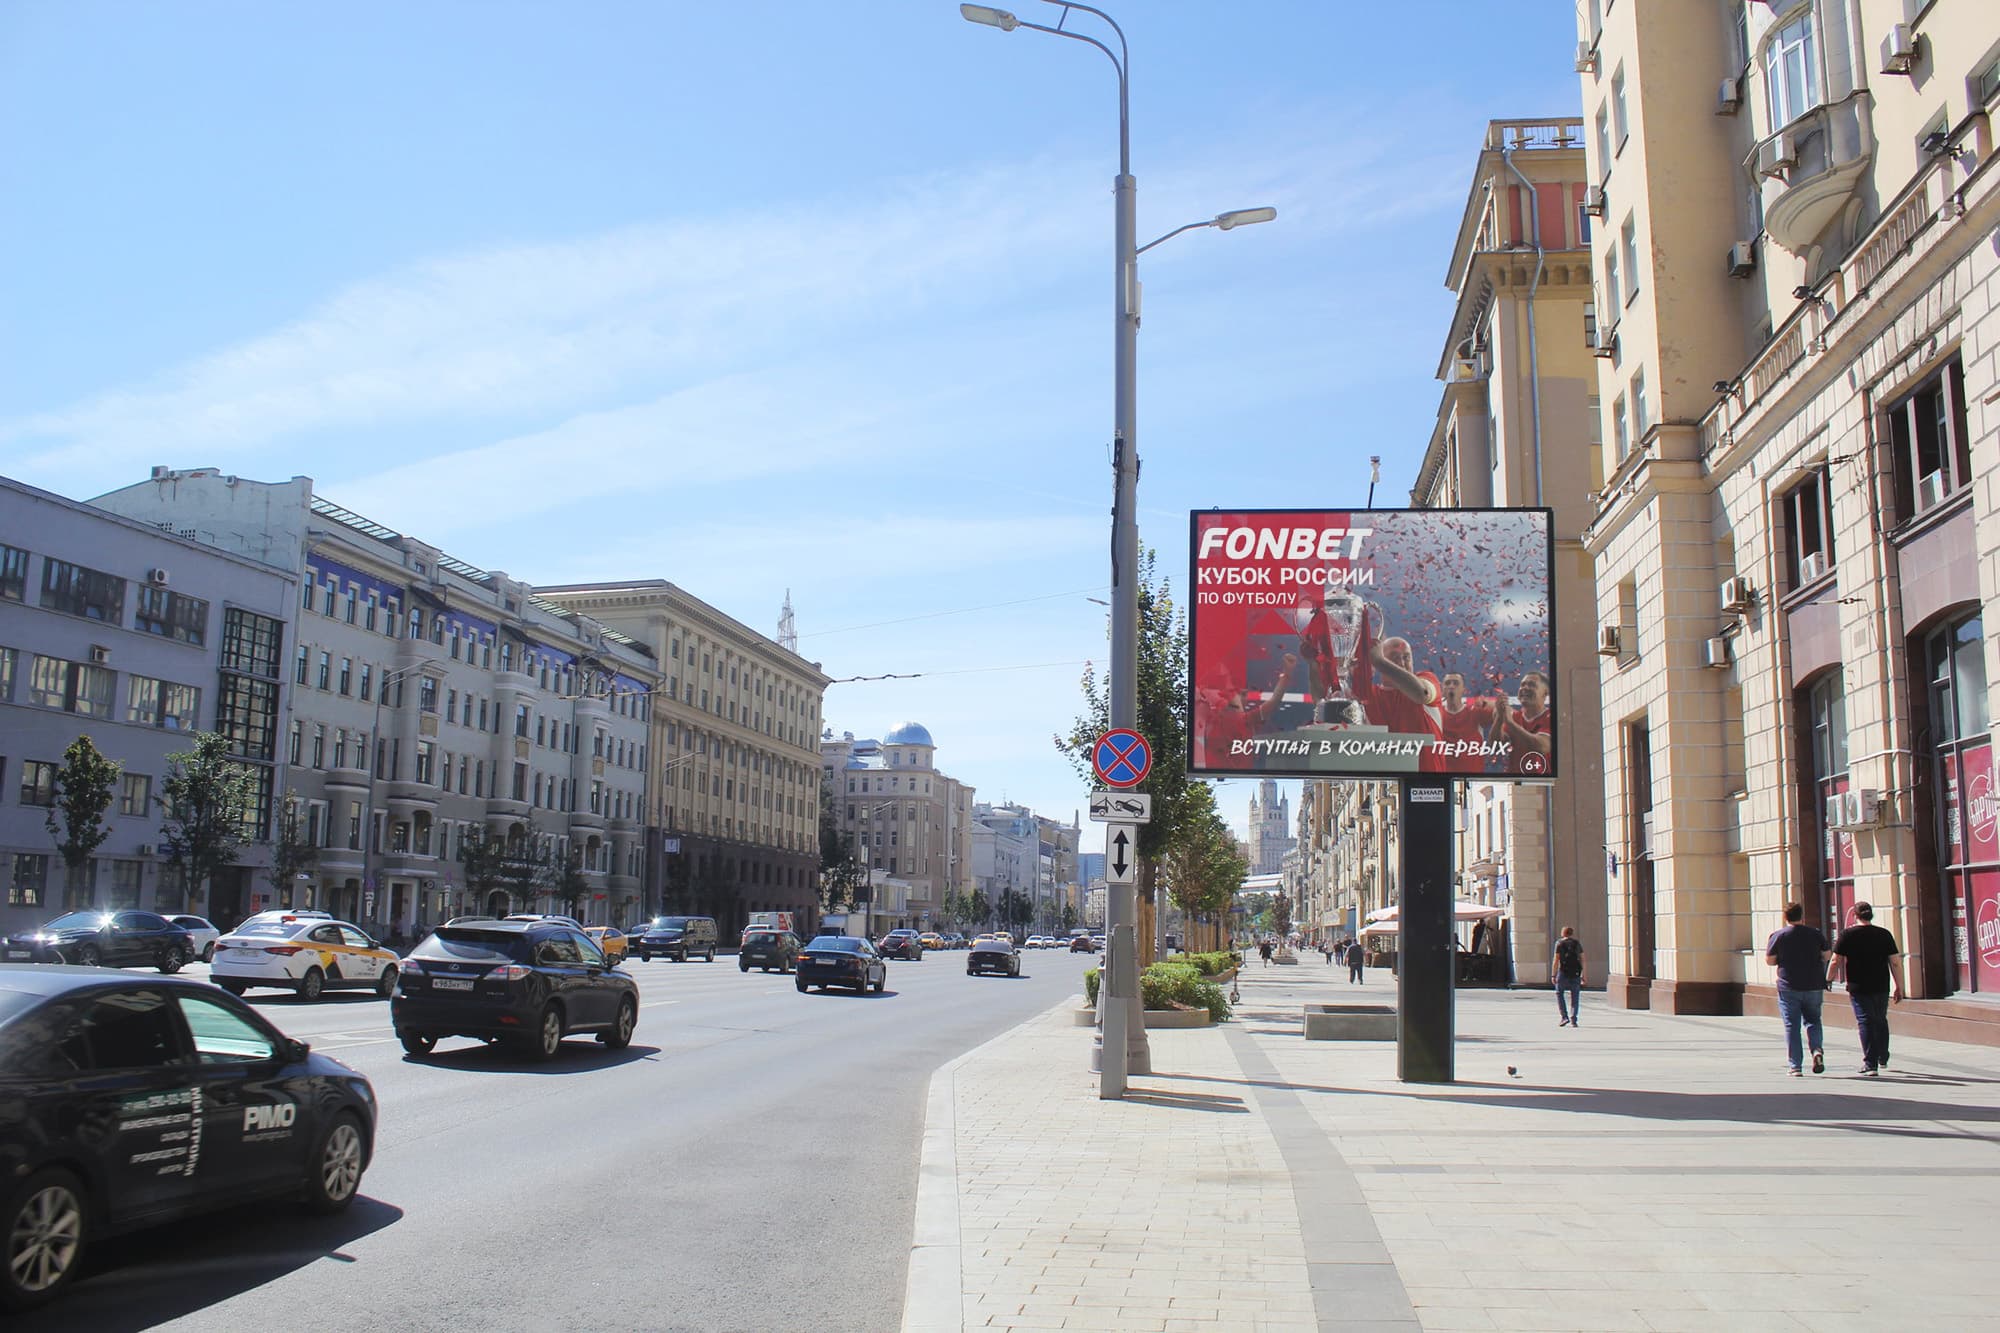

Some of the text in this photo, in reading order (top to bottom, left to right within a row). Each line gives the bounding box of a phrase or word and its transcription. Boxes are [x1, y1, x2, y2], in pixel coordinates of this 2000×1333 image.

[1198, 527, 1373, 560] FONBET
[1198, 567, 1374, 585] КУБОК РОССИИ
[1198, 591, 1297, 606] ПО ФУТБОЛУ
[1231, 739, 1509, 758] ВСТУПАЙ В КОМАНДУ ПЕРВЫХ
[1525, 759, 1541, 770] 6+
[243, 1103, 296, 1131] PIMO
